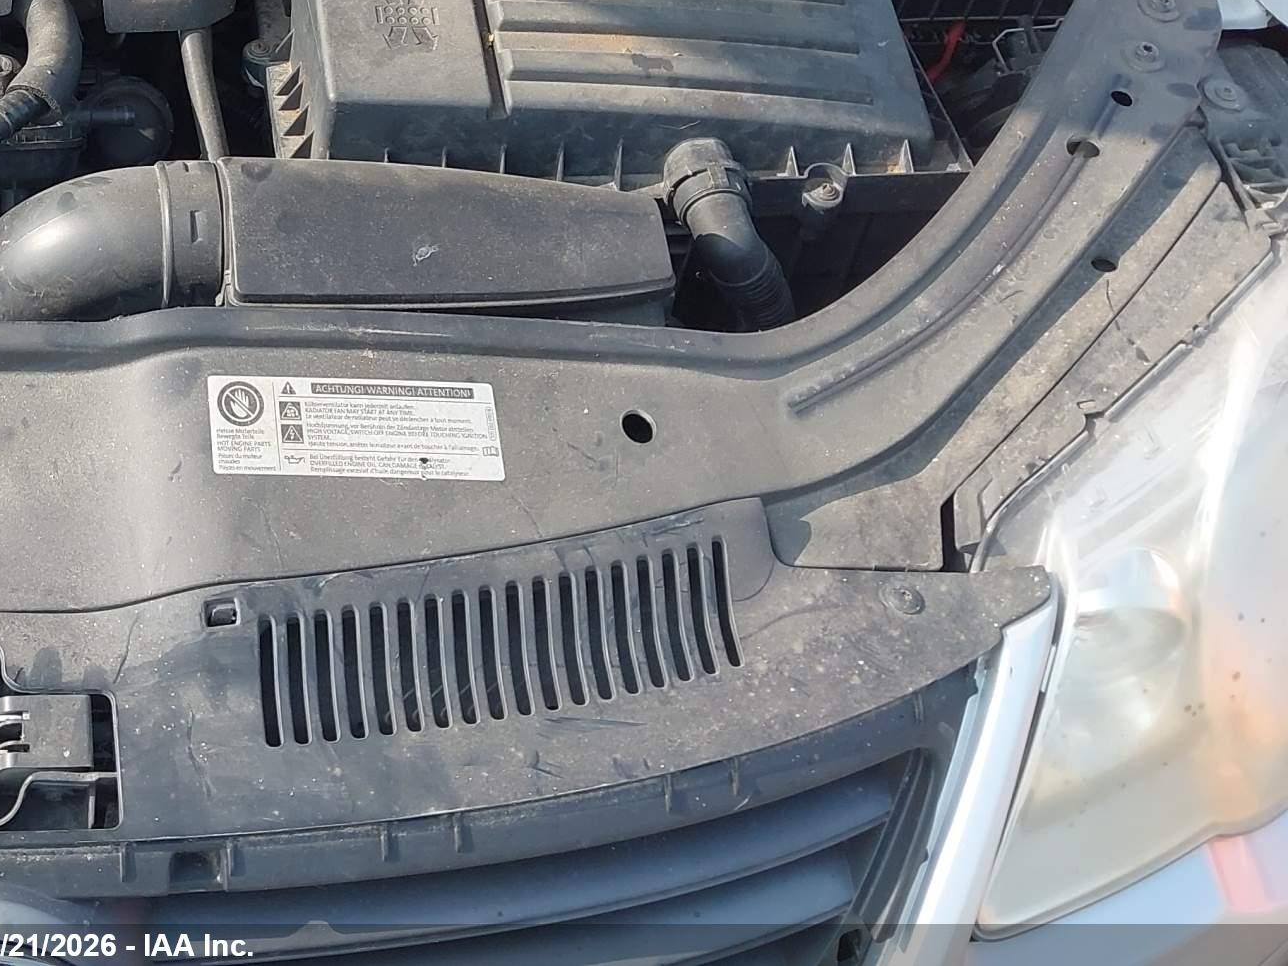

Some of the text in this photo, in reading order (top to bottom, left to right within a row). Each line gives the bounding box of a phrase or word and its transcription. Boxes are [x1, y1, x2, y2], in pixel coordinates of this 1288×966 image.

[315, 384, 472, 398] ACHTUNG! WARNING! ATTENTION!
